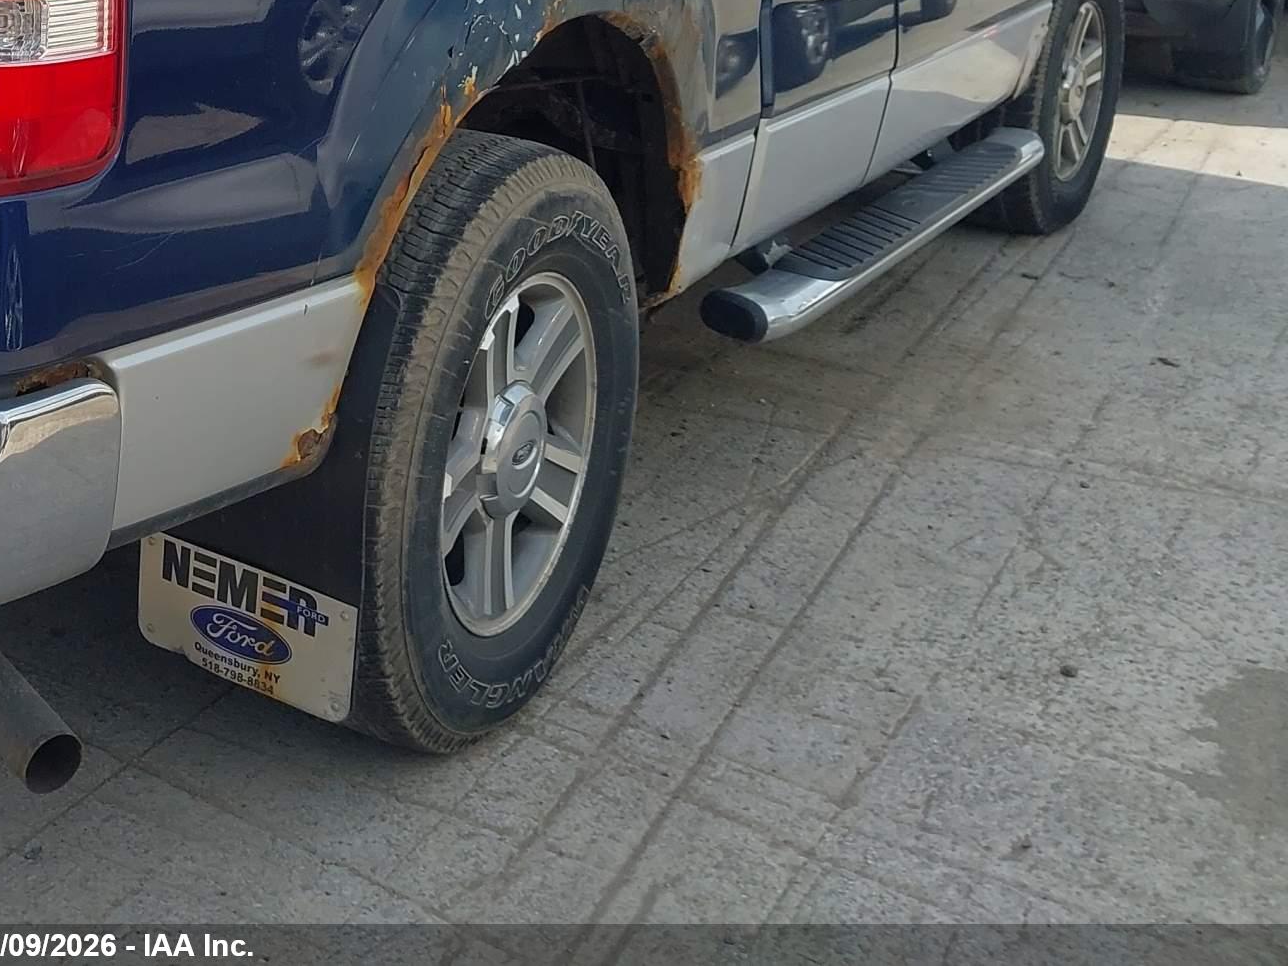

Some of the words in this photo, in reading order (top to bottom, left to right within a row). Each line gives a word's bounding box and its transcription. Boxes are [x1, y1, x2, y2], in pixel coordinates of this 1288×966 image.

[484, 210, 633, 320] GOODYEAR
[162, 538, 318, 638] NEMER
[205, 612, 279, 658] Ford
[296, 605, 326, 624] FORD
[194, 641, 261, 679] Queensbury,
[264, 669, 281, 685] NY
